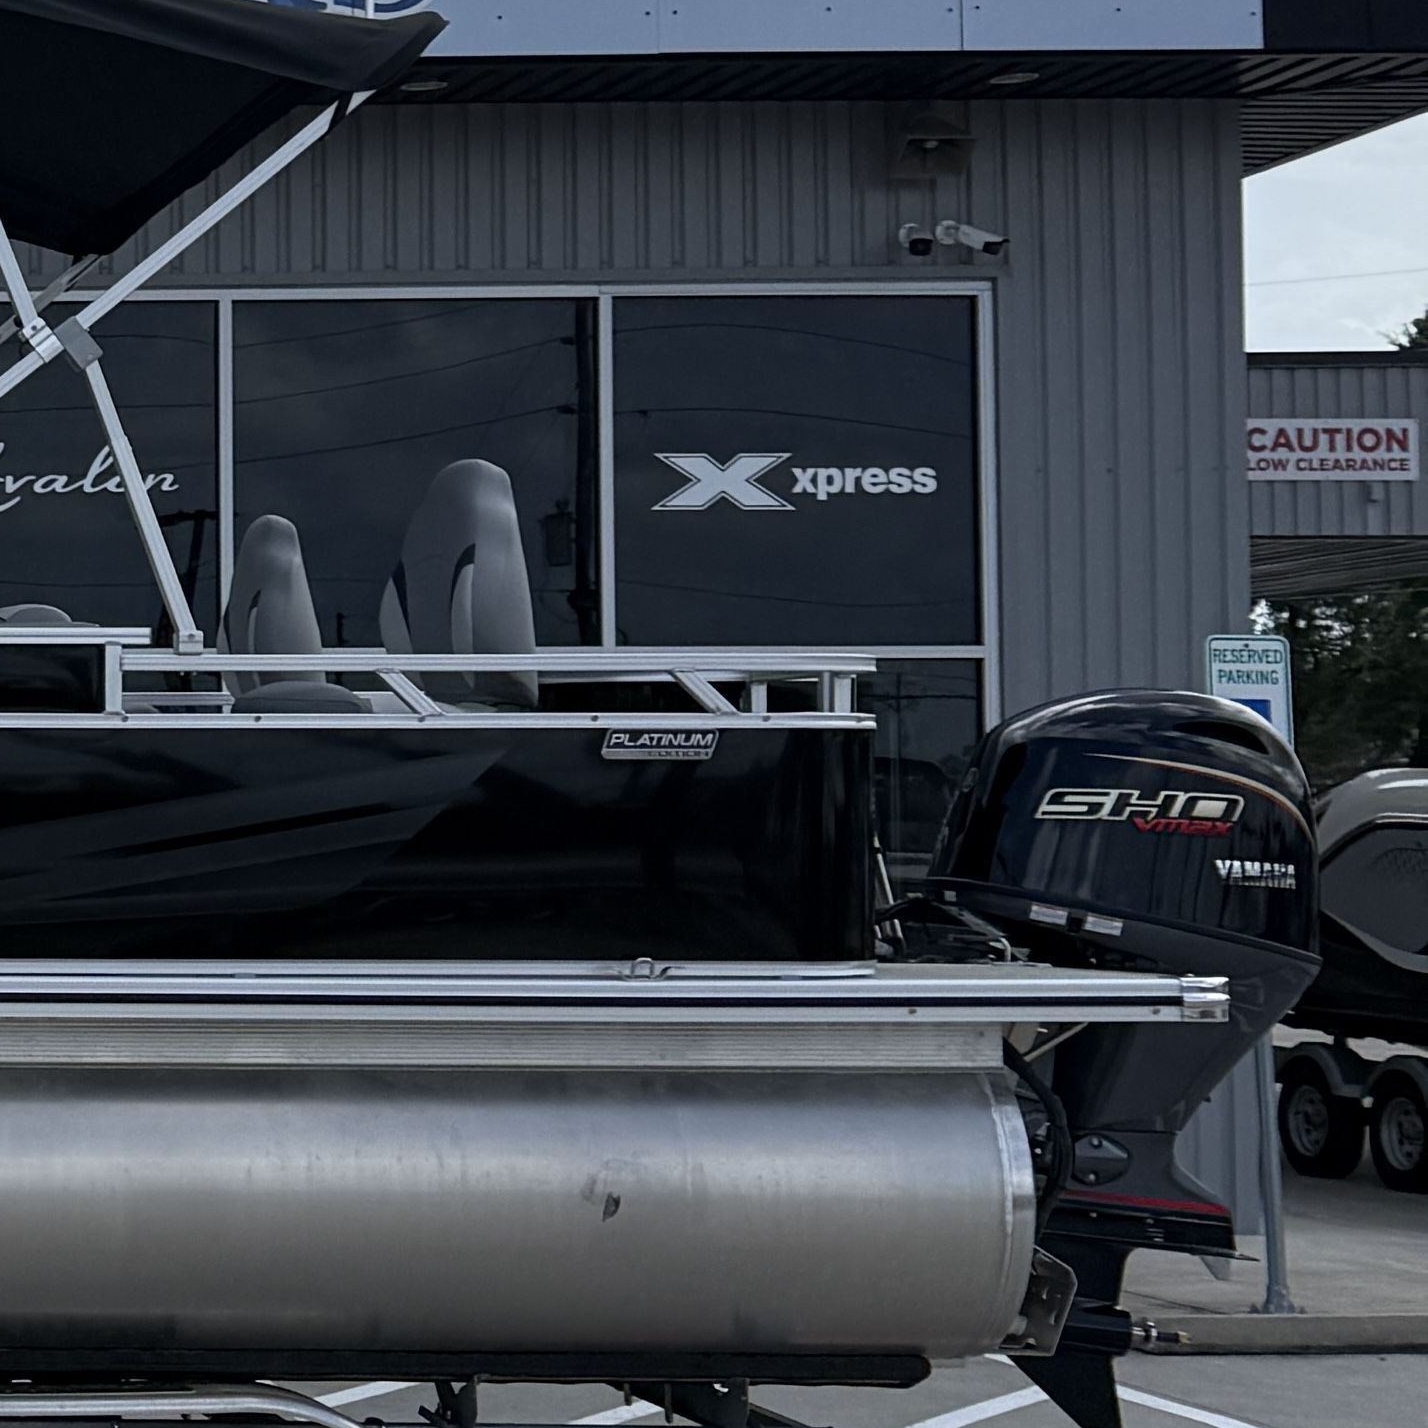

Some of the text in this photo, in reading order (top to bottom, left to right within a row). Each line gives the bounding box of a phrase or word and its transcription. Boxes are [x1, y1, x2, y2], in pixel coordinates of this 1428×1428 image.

[1247, 427, 1410, 453] CAUTION
[1296, 457, 1411, 472] CLEARANCE
[791, 466, 938, 501] xpress
[1212, 648, 1284, 664] RESERVED
[1217, 668, 1279, 685] PARKING
[609, 733, 714, 746] PLATINUM
[1033, 787, 1245, 822] SHO
